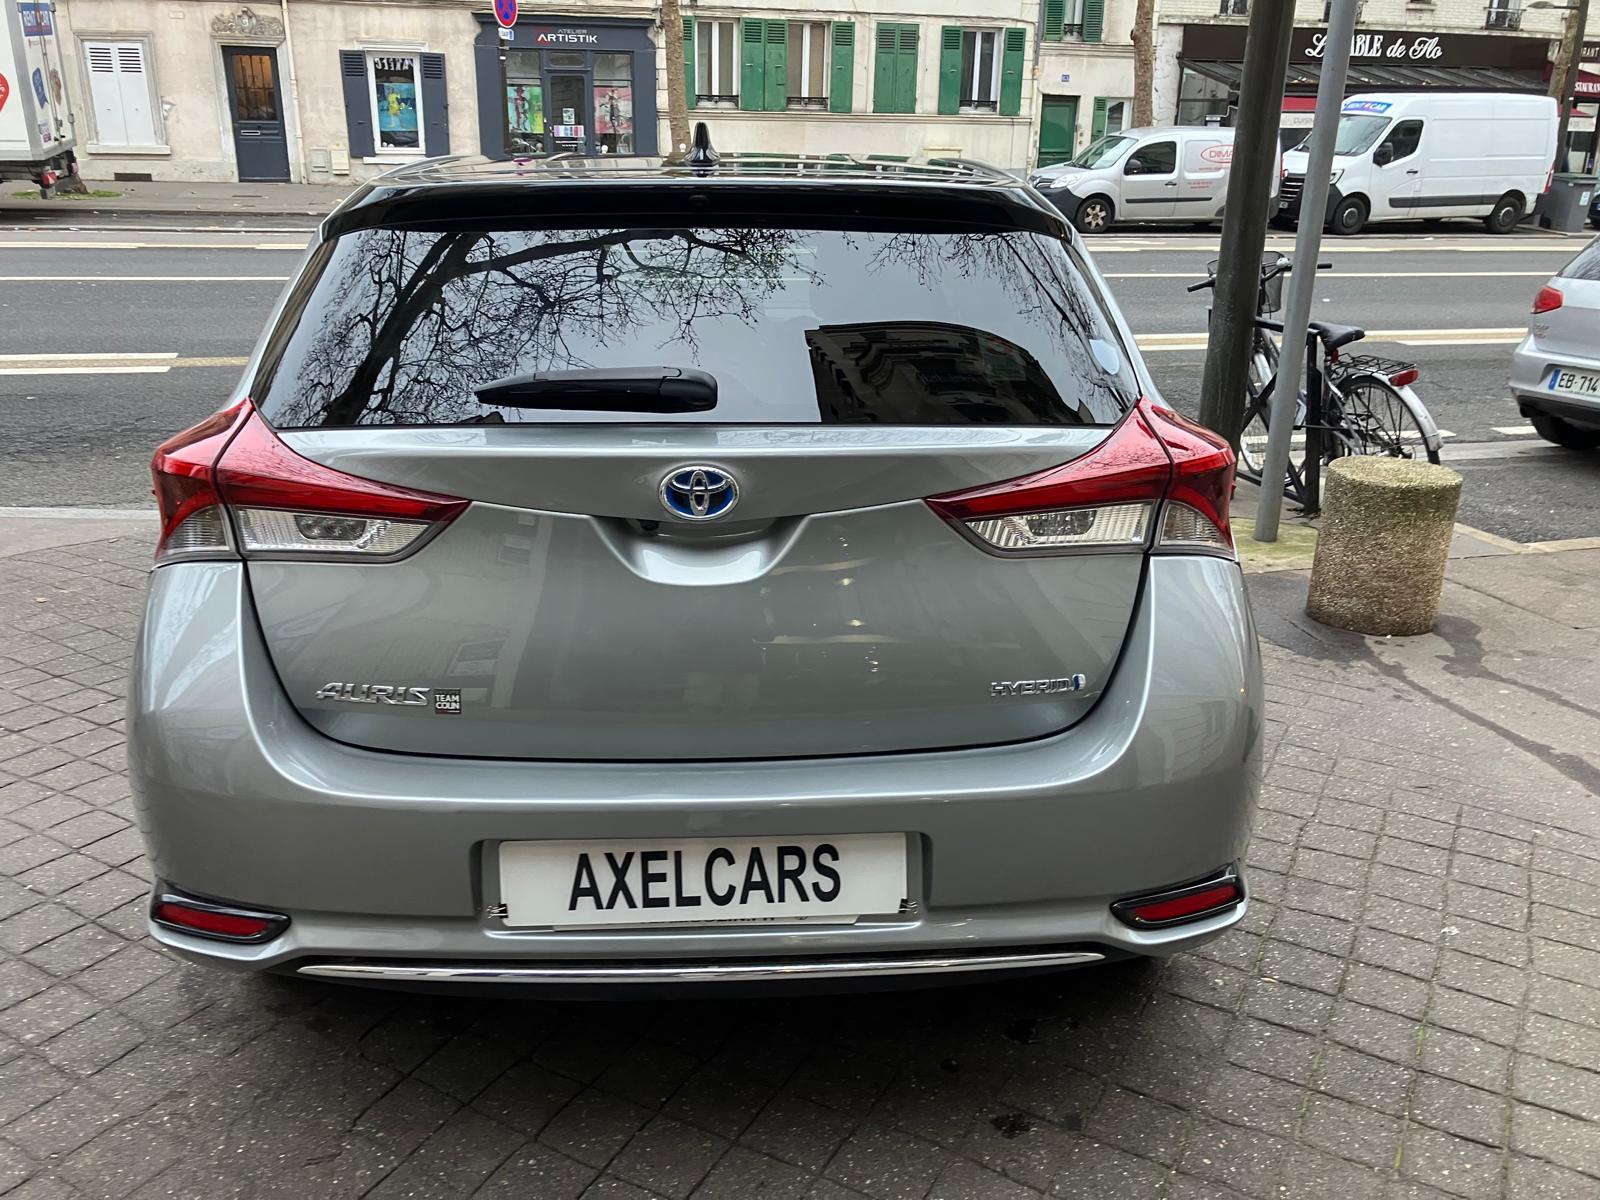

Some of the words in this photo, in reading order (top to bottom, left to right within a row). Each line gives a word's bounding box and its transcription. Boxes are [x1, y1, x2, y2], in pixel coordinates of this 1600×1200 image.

[537, 34, 598, 43] ARTISTIK
[1350, 34, 1384, 57] ABLE
[1386, 38, 1406, 58] de
[1408, 36, 1443, 60] Flo
[314, 682, 430, 706] AURIS
[990, 678, 1071, 696] HYBRID
[434, 694, 460, 702] TEAM
[568, 843, 841, 911] AXELCARS
